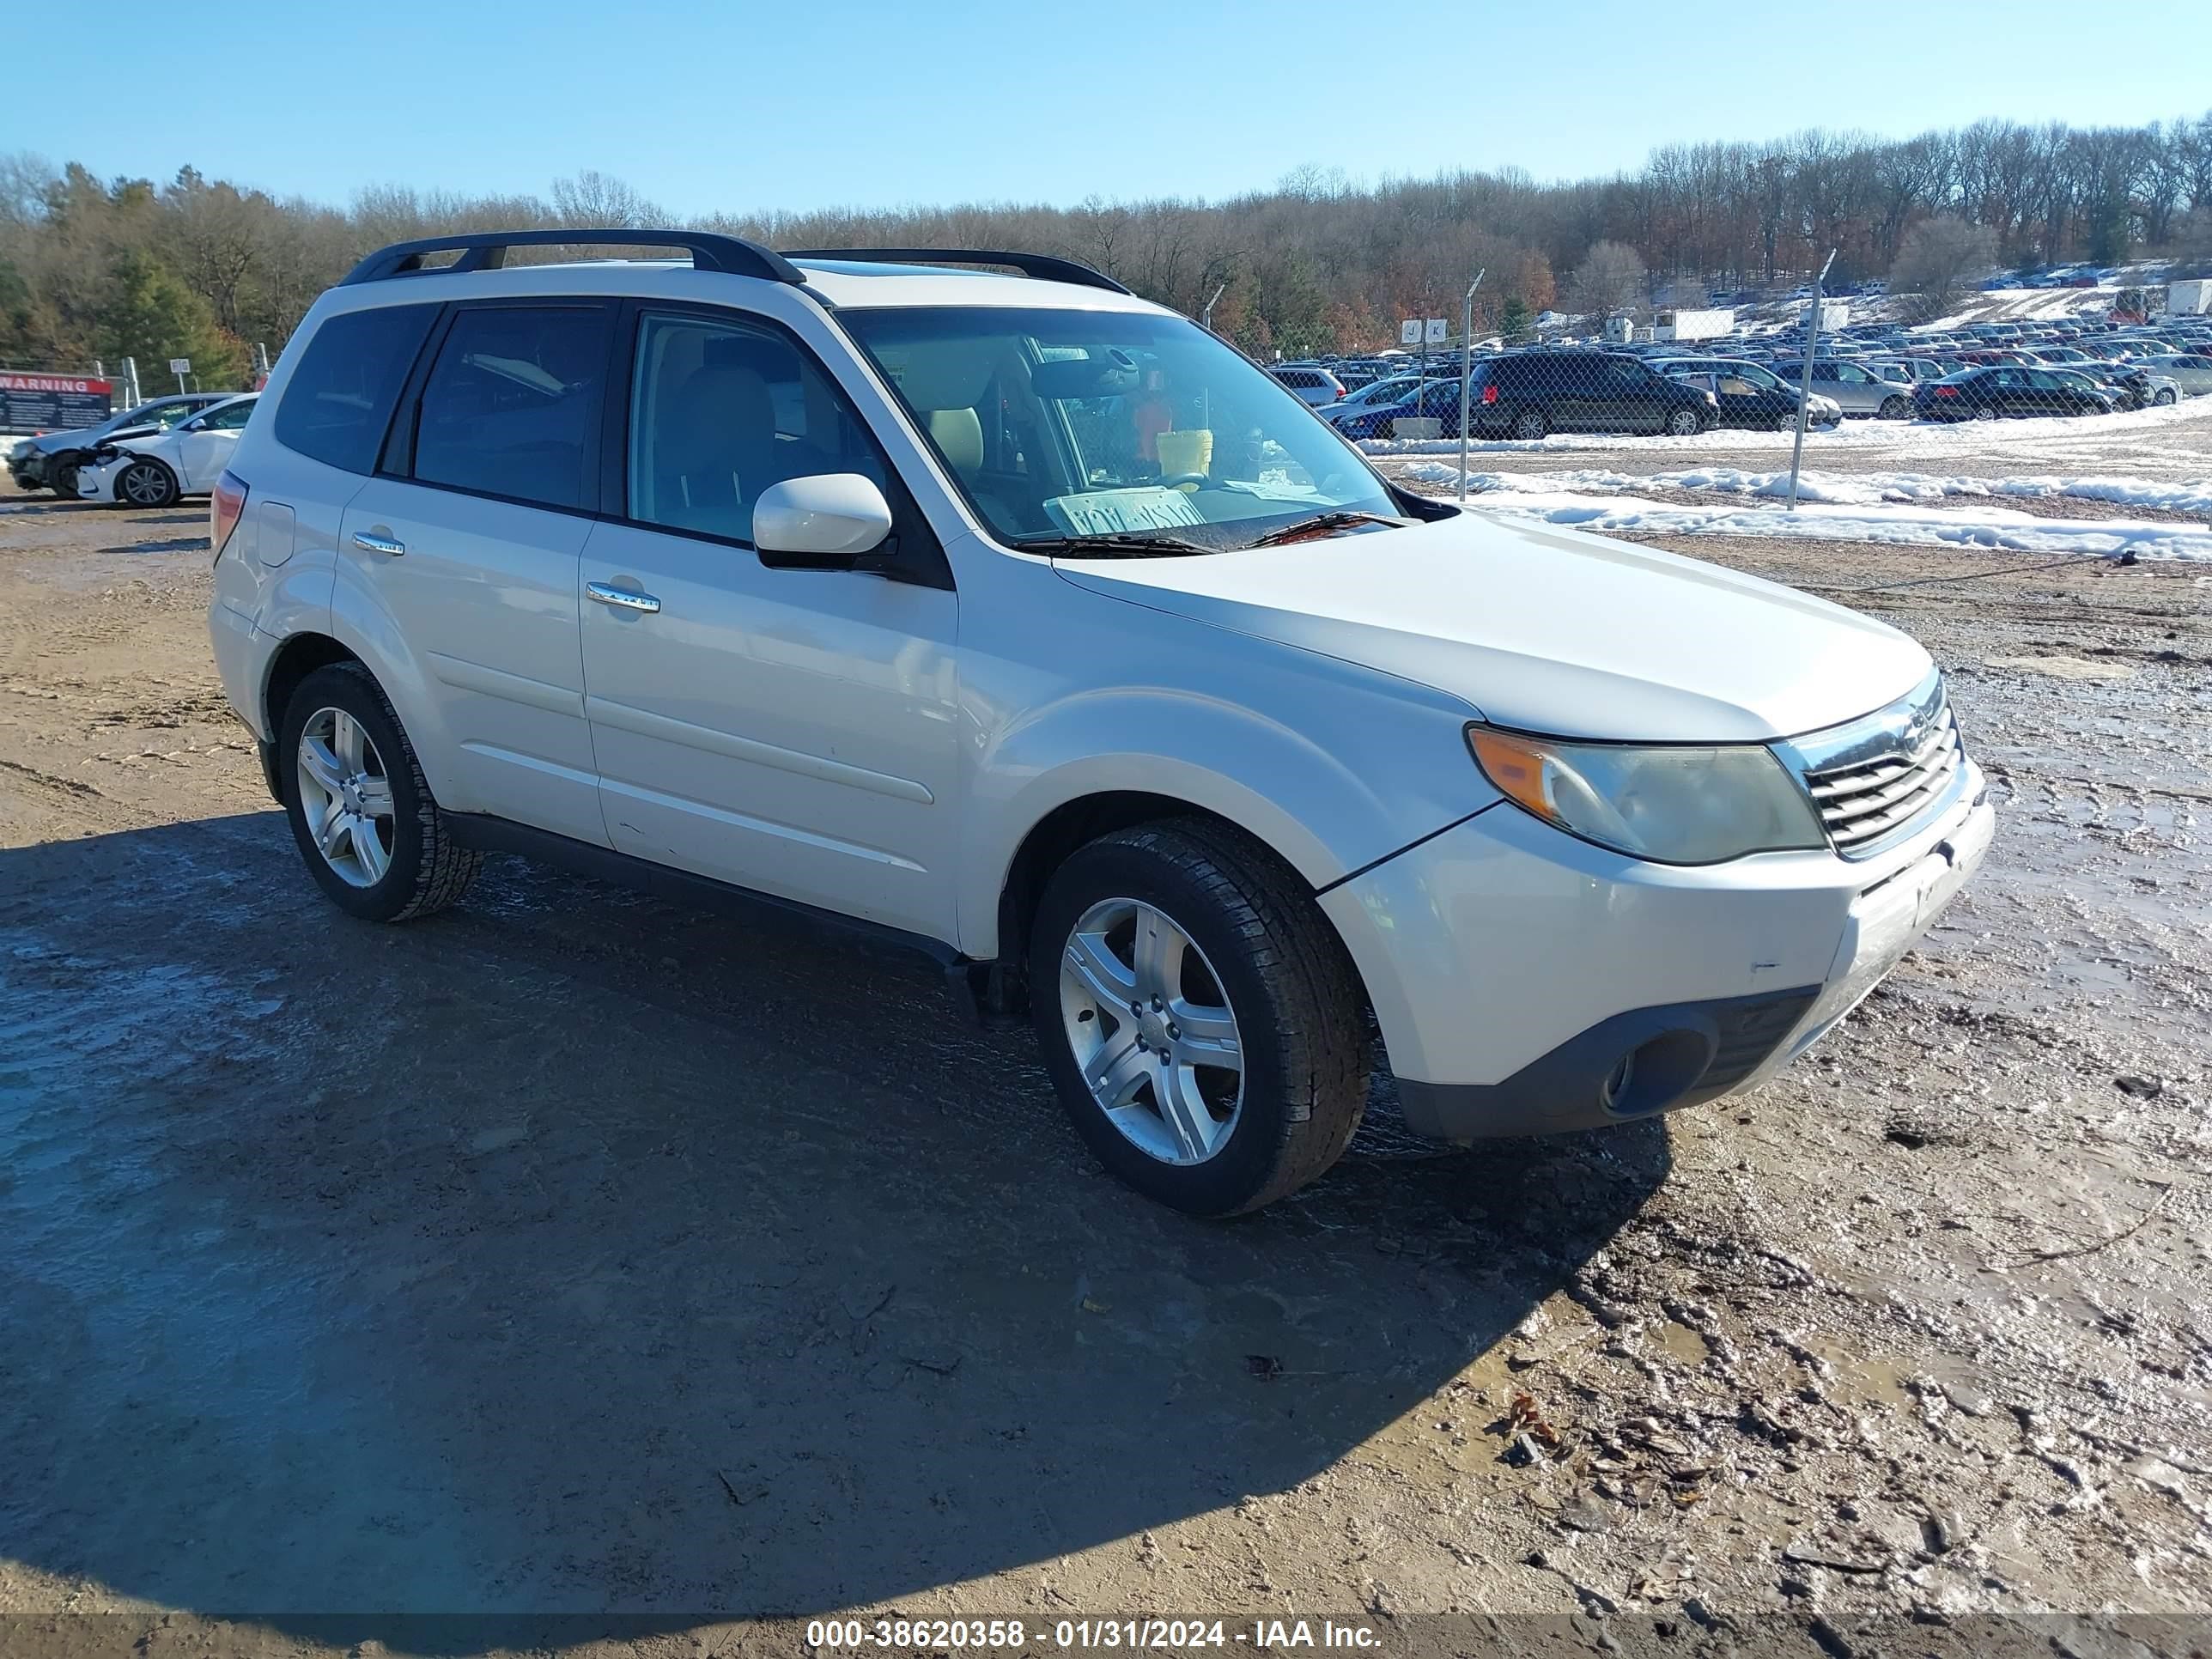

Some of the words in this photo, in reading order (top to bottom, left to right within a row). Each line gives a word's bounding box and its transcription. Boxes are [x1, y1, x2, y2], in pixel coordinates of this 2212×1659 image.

[1408, 325, 1415, 336] J
[1433, 325, 1439, 336] K
[0, 376, 88, 392] WARNING
